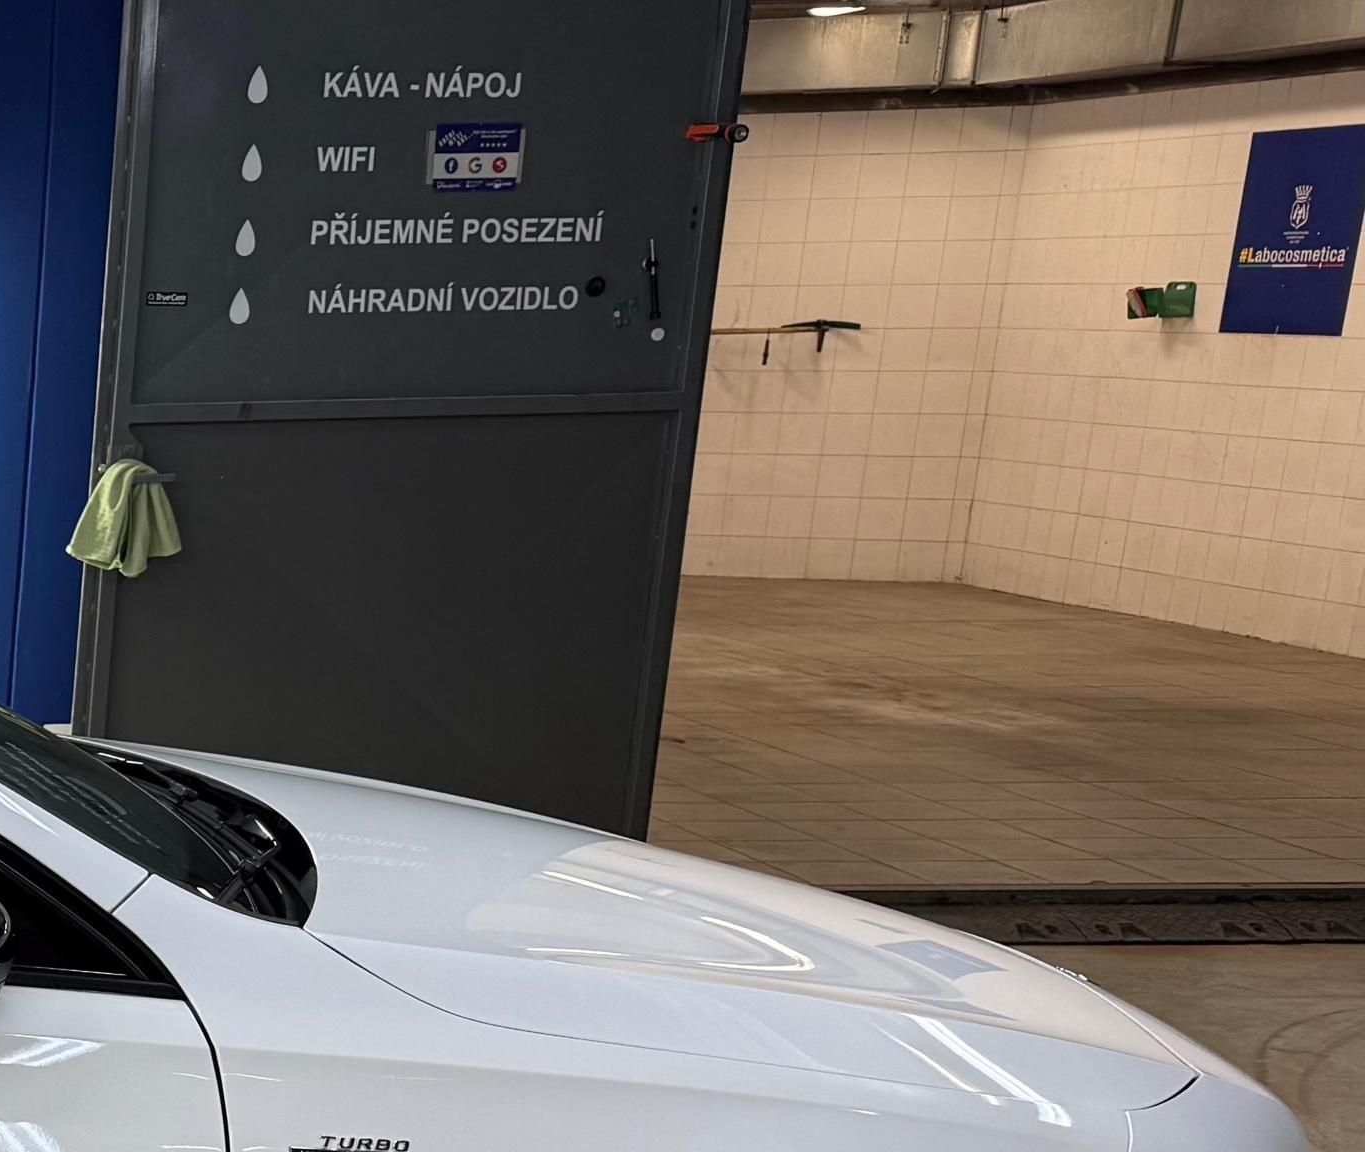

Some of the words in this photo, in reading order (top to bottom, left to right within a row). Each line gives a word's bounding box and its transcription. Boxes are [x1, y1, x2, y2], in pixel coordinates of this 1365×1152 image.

[322, 65, 400, 98] KÁVA
[424, 65, 522, 99] NÁPOJ
[316, 146, 376, 173] WIFI
[310, 211, 454, 245] PŘÍJEMNÉ
[461, 210, 605, 244] POSEZENÍ
[1238, 245, 1346, 264] #Labocosmetica
[307, 281, 454, 315] NÁHRADNÍ
[461, 285, 579, 312] VOZIDLO
[320, 1135, 410, 1152] TURBO
